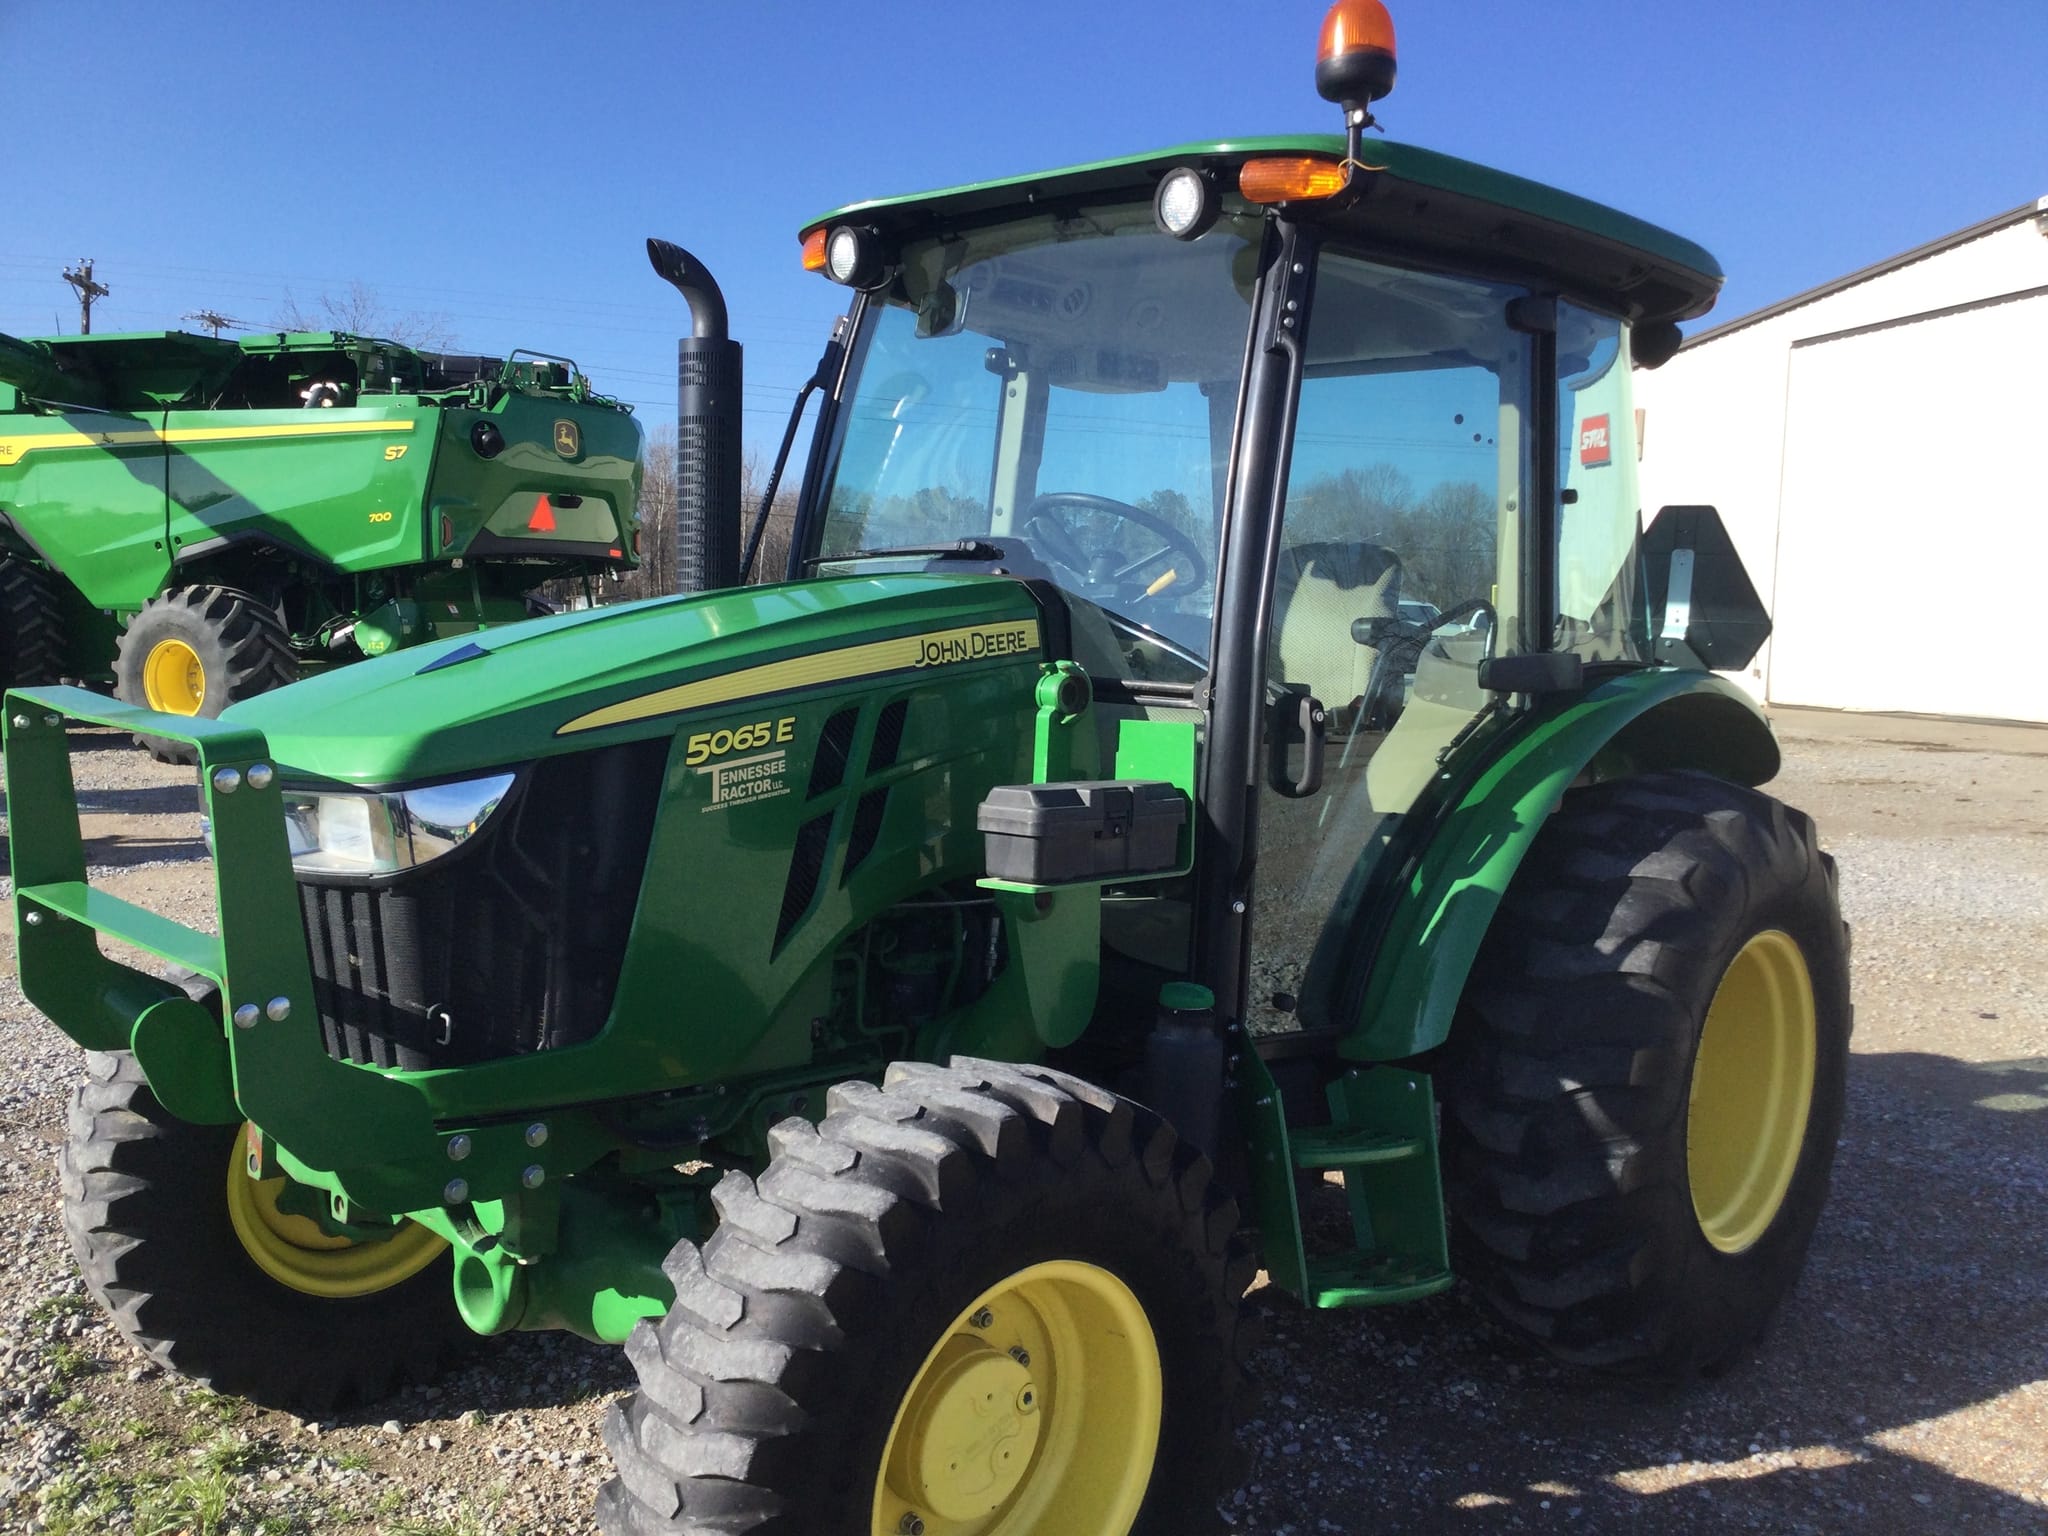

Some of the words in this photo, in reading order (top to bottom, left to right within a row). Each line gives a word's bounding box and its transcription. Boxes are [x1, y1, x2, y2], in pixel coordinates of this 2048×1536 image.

[384, 445, 409, 461] S7
[369, 511, 392, 523] 700
[915, 638, 968, 665] JOHN
[971, 630, 1027, 657] DEERE
[685, 721, 772, 766] 5065
[776, 716, 796, 743] E
[697, 750, 786, 787] TENNESSEE
[772, 780, 784, 790] LLC
